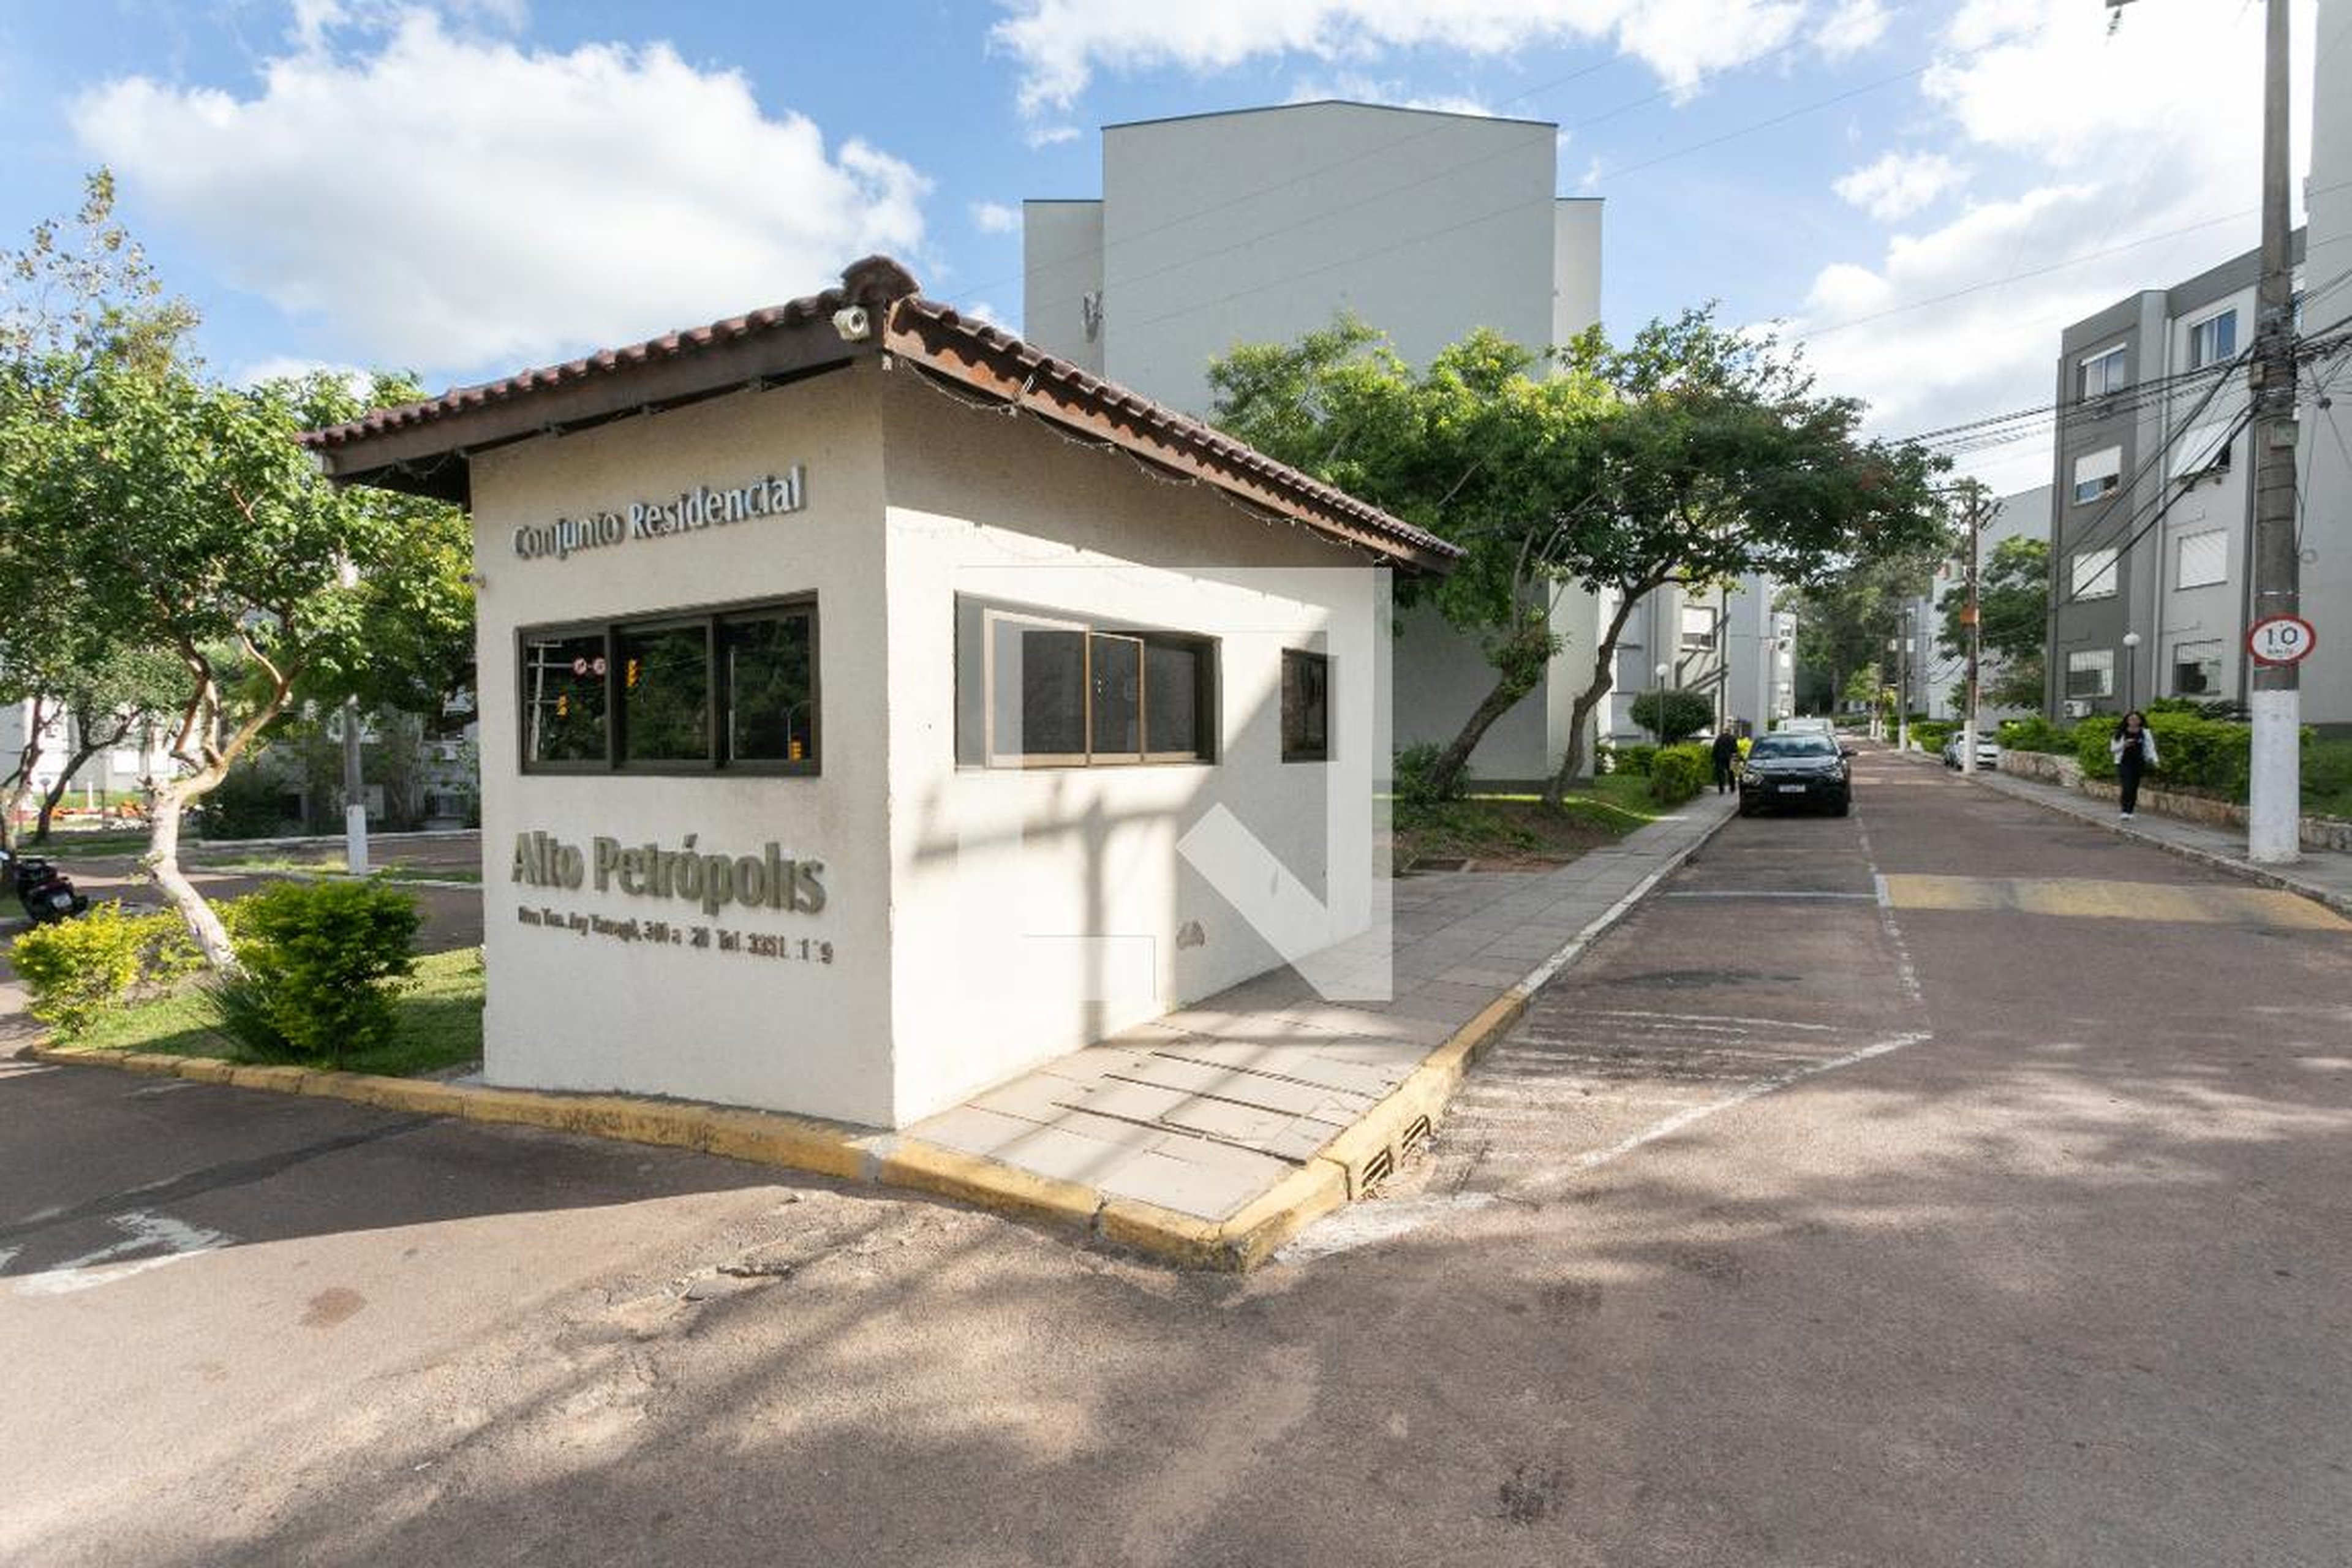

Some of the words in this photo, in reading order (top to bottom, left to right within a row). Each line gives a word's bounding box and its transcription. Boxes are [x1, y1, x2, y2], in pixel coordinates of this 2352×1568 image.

[511, 512, 625, 559] Conjunto
[628, 462, 805, 540] Residencial
[2267, 626, 2298, 646] 10
[511, 831, 584, 890] Alto
[594, 833, 827, 917] Petrópolis
